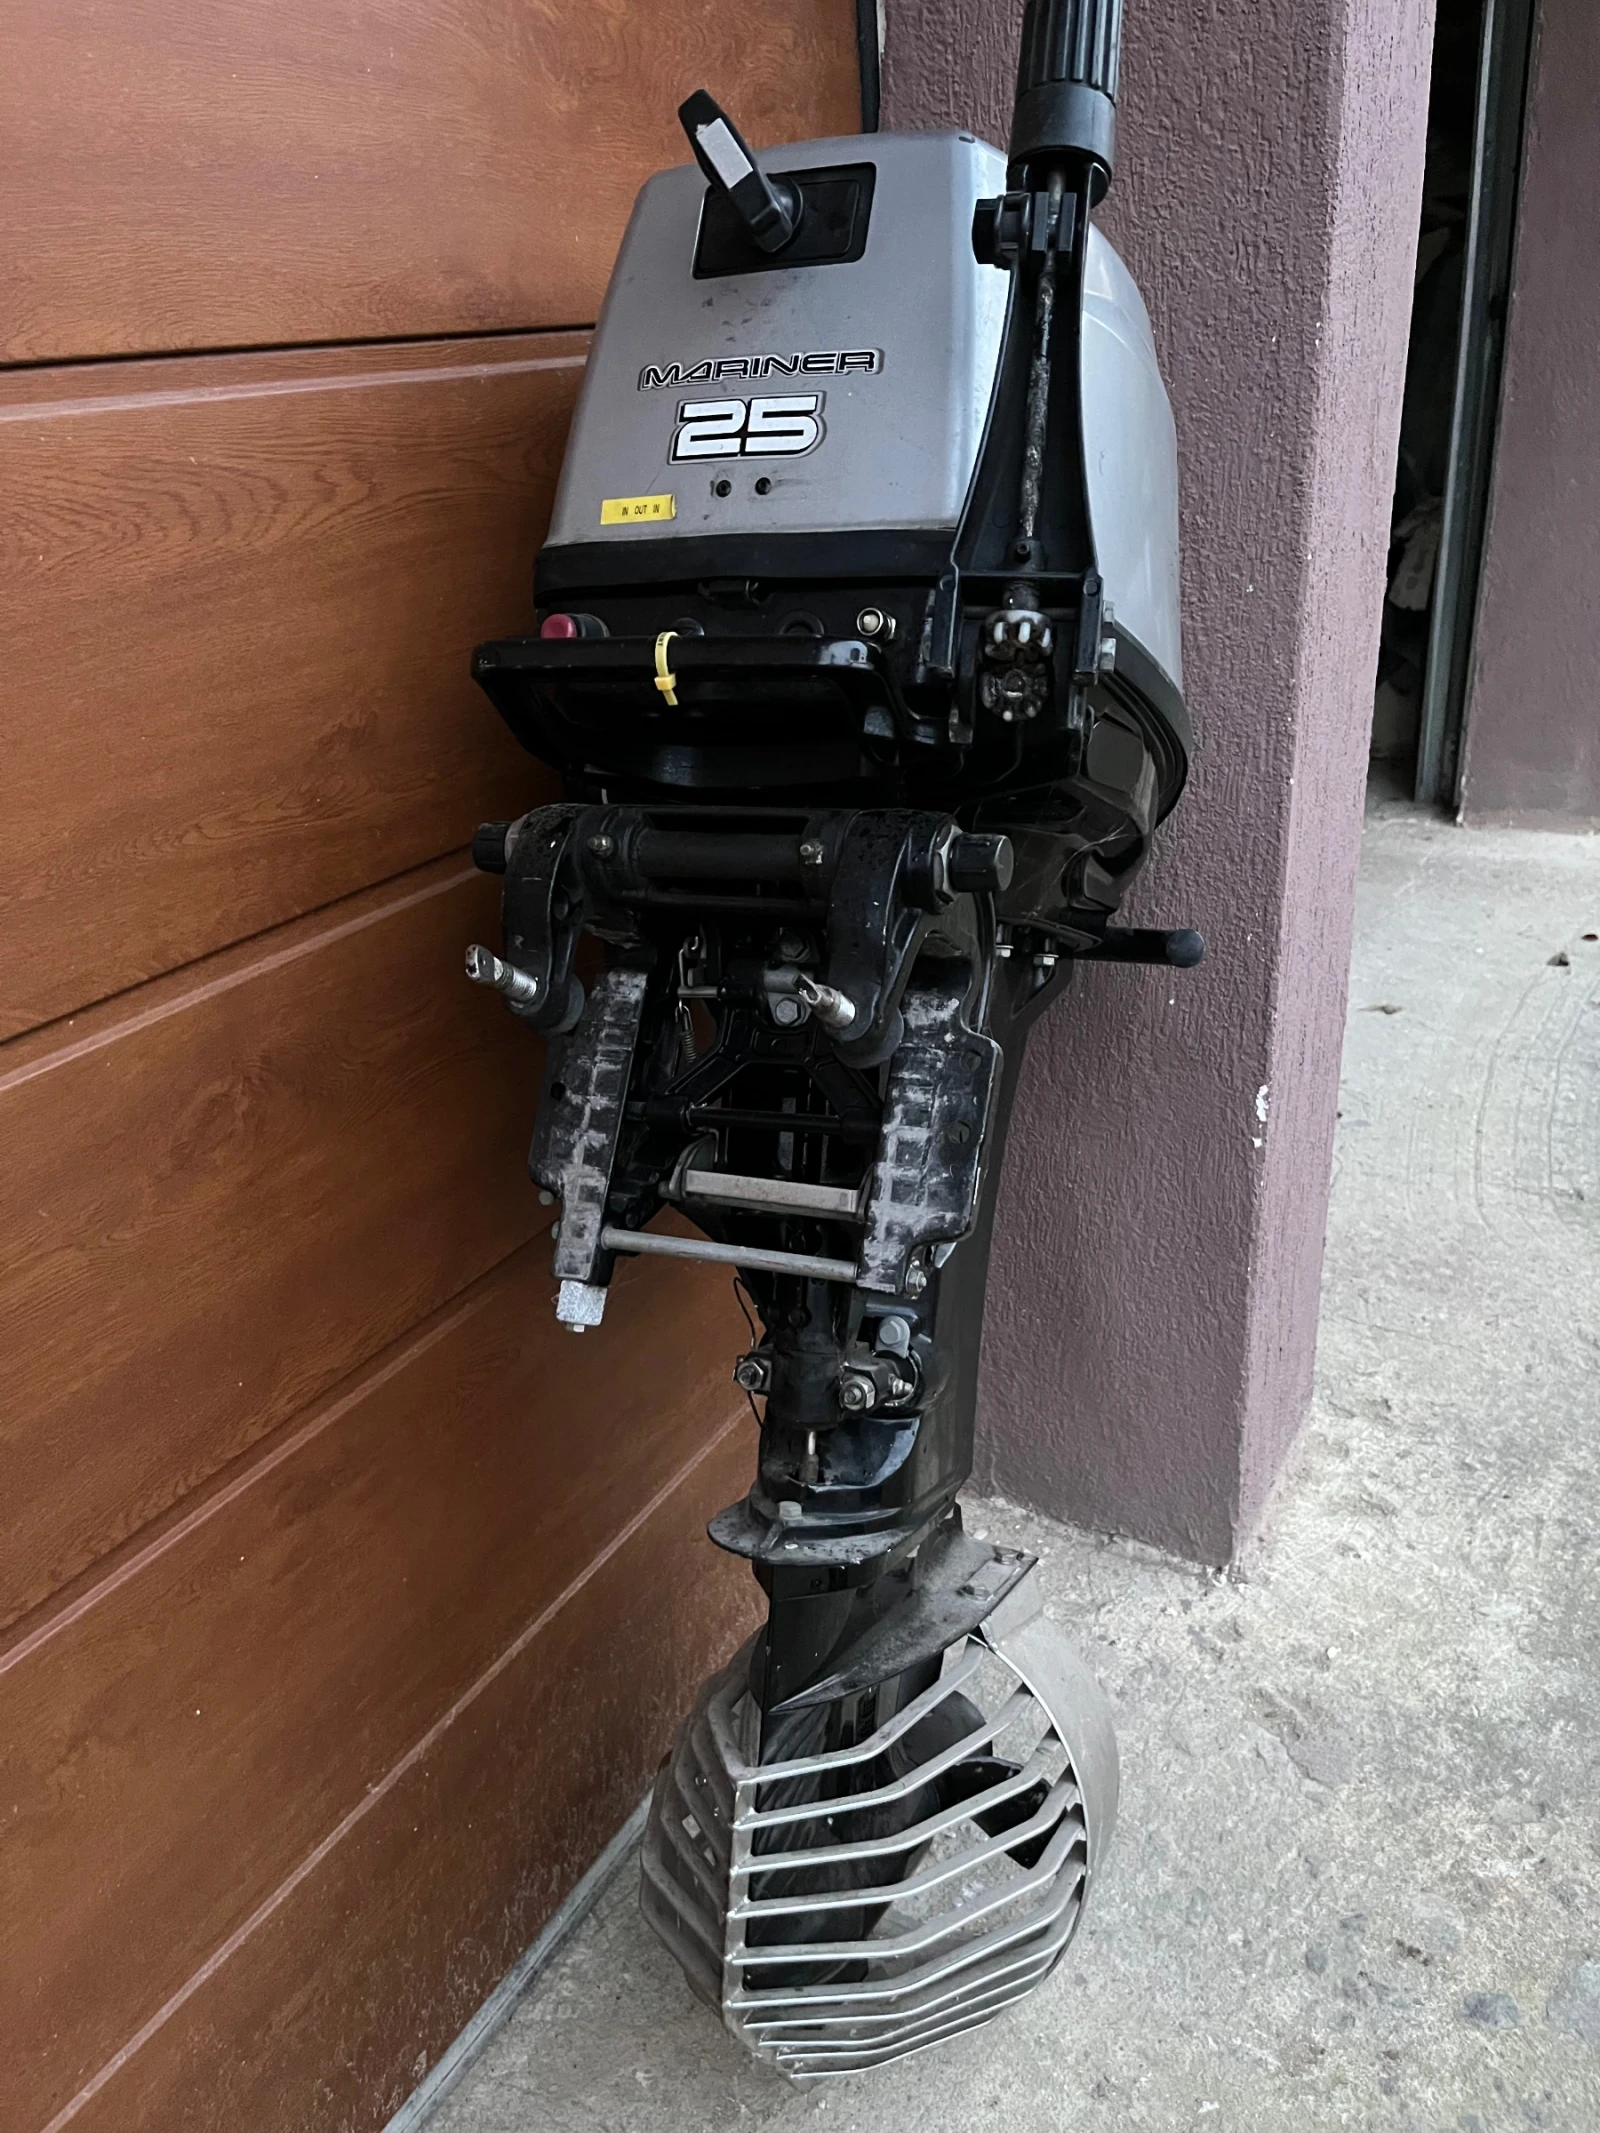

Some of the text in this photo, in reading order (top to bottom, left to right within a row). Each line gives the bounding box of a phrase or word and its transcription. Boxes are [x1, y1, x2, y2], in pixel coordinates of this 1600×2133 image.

[641, 350, 879, 389] MARINER
[672, 395, 820, 461] 25
[621, 503, 660, 516] IN OUT IN
